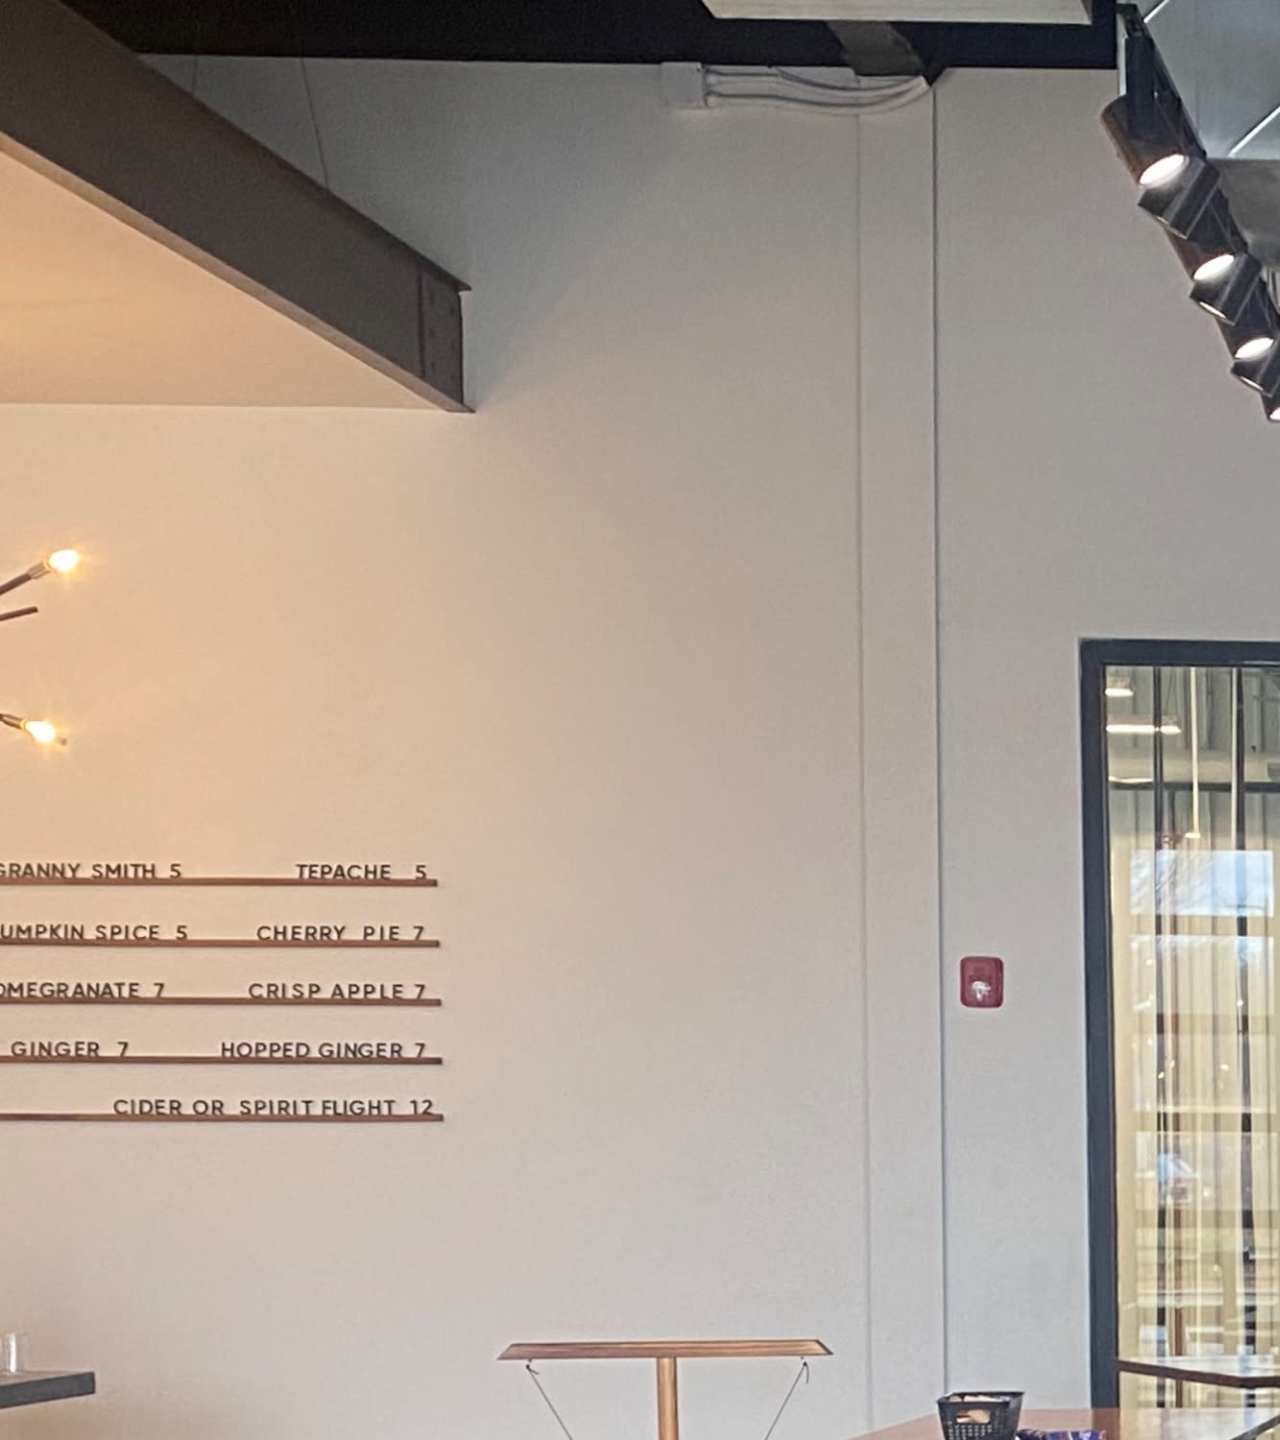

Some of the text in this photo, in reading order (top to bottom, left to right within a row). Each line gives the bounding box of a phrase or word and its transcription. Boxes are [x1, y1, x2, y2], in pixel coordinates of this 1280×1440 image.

[91, 863, 156, 879] SMITH
[169, 863, 182, 879] 5
[296, 864, 427, 880] TEPACHE 5
[95, 925, 160, 941] SPICE
[176, 925, 188, 941] 5
[256, 925, 424, 941] CHERRY PIE 7
[153, 983, 165, 998] 7
[248, 983, 426, 999] CRISP APPLE 7
[11, 1041, 129, 1057] GINGER 7
[221, 1042, 426, 1058] HOPPED GINGER 7
[113, 1099, 433, 1115] CIDER OR SPIRIT FLIGHT 12
